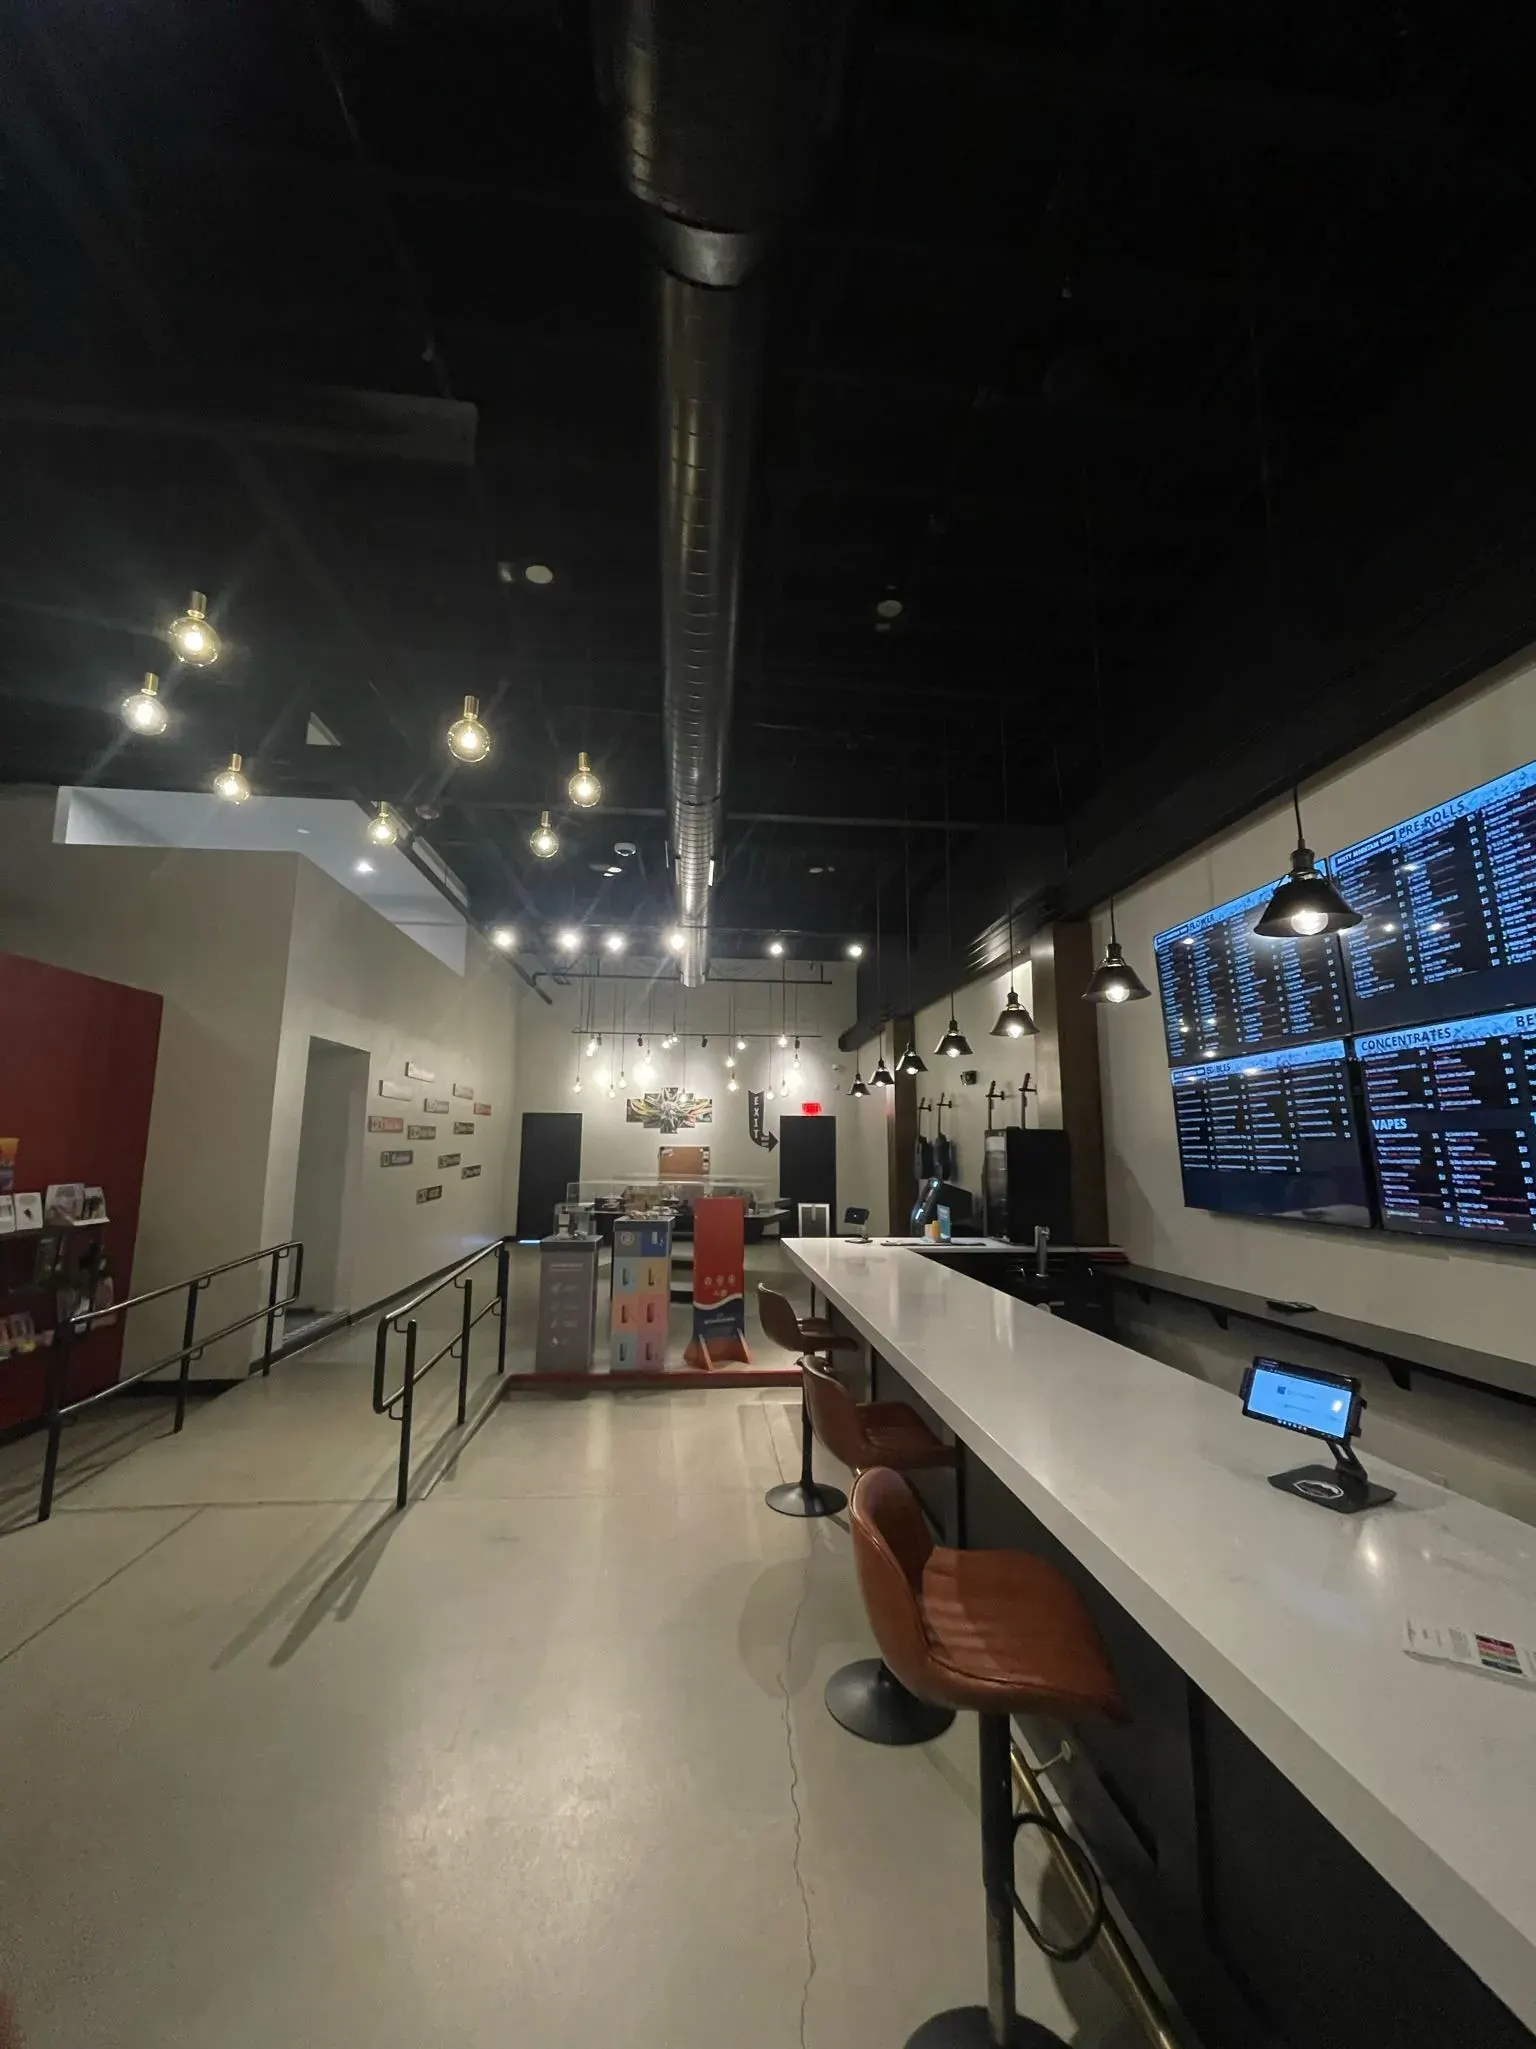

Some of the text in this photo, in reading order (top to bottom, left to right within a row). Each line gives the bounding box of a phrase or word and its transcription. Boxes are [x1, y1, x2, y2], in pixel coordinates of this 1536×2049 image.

[1399, 799, 1465, 838] PRE-ROLLS
[1516, 1011, 1536, 1027] BE
[1361, 1027, 1450, 1050] CONCENTRATES
[1372, 1118, 1407, 1130] VAPES
